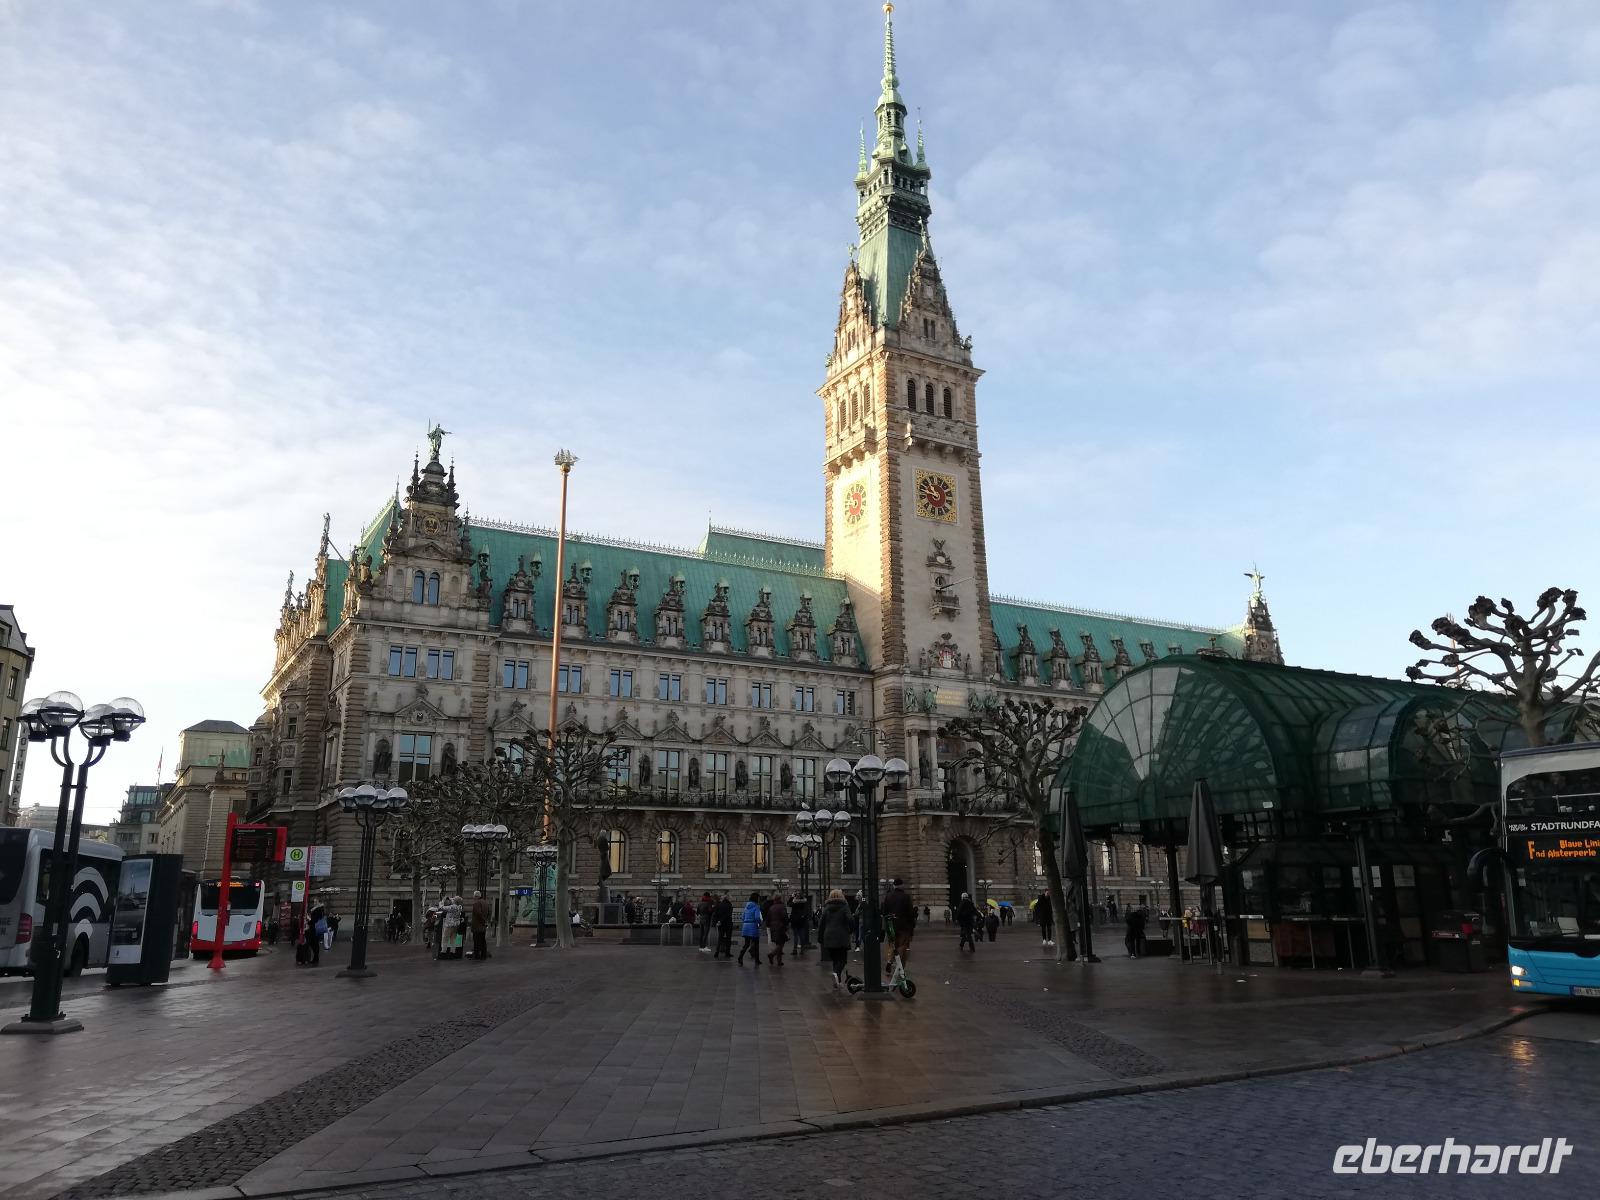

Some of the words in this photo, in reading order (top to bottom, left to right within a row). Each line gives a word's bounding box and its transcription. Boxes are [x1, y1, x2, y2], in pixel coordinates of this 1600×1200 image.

[1530, 820, 1600, 831] STADTRUNDFA
[1559, 839, 1583, 849] Blaue
[1527, 840, 1535, 860] F
[1547, 848, 1597, 858] Alsterperle
